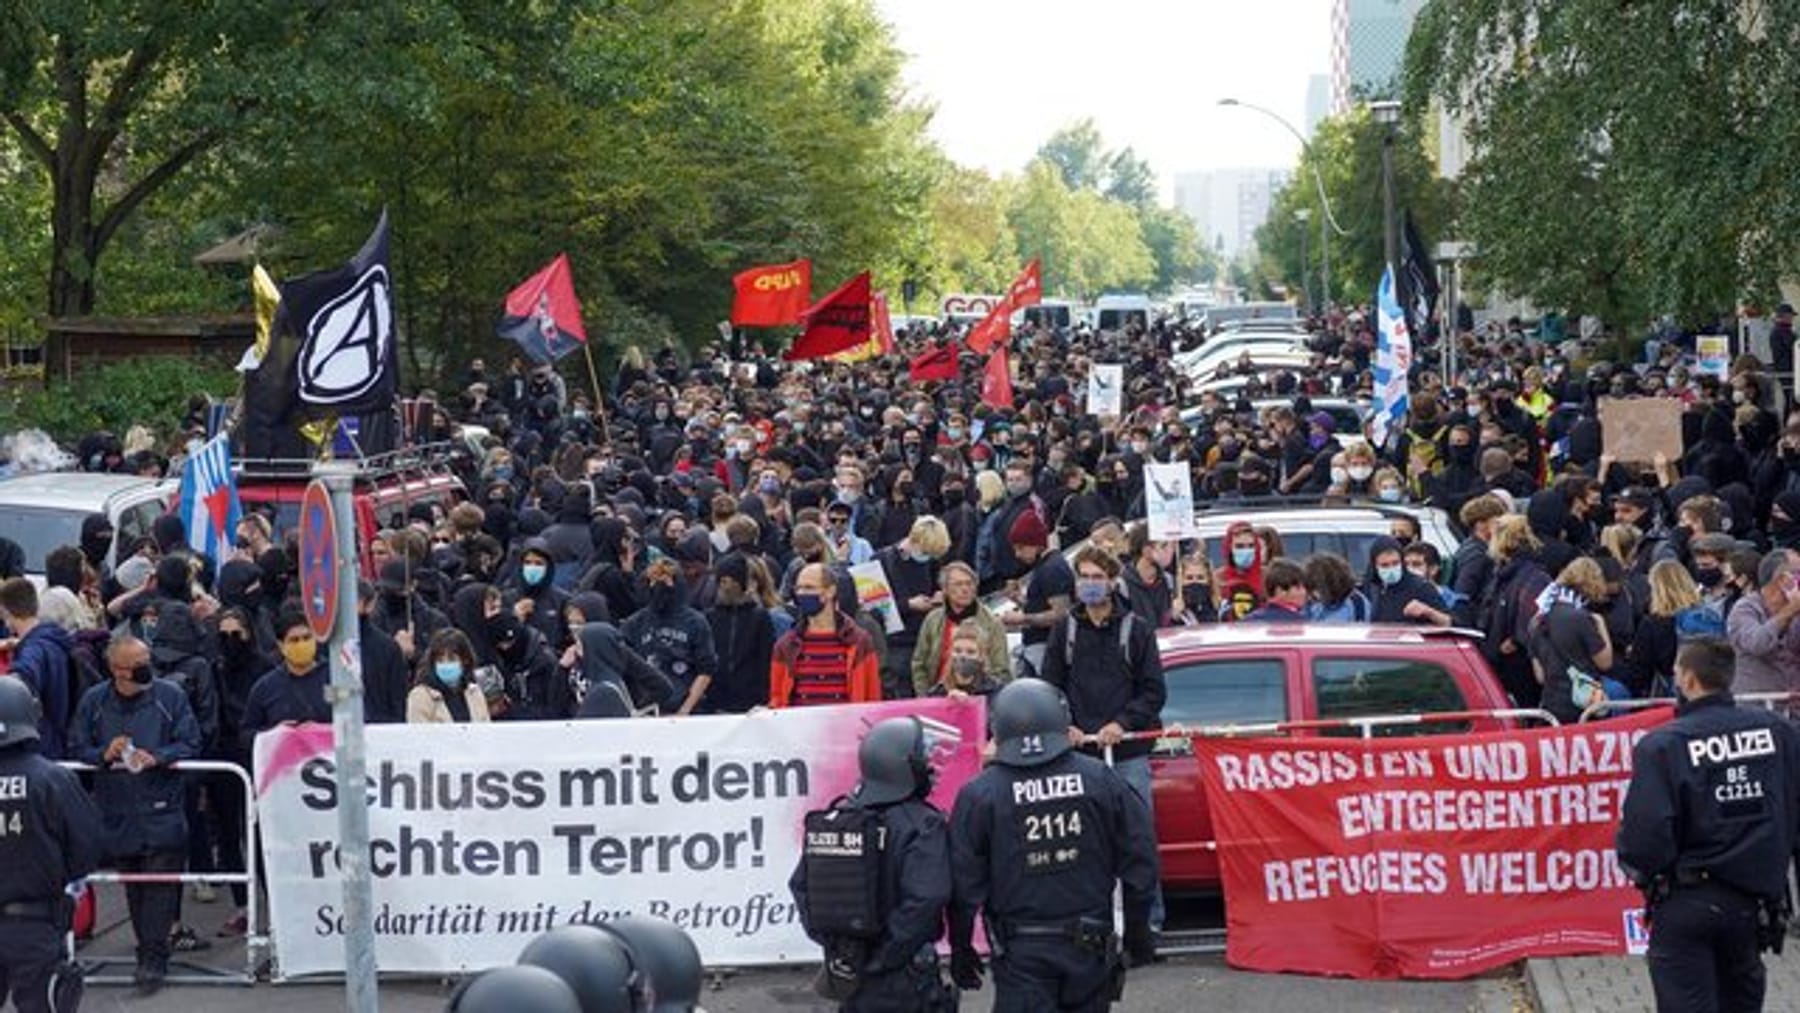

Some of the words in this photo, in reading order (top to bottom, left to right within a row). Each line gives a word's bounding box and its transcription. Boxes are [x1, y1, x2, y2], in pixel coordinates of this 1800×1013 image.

[1687, 728, 1776, 766] POLIZEI
[559, 754, 659, 807] mit
[671, 751, 808, 803] dem
[1215, 750, 1434, 791] RASSISTEN
[1444, 740, 1528, 782] UND
[1726, 765, 1748, 783] BE
[1012, 774, 1084, 803] POLIZEI
[1715, 781, 1764, 802] C1211
[1025, 812, 1081, 839] 2114
[309, 826, 540, 878] rchten
[553, 816, 764, 874] Terror!
[1264, 850, 1447, 901] REFUGEES
[496, 903, 558, 932] mit
